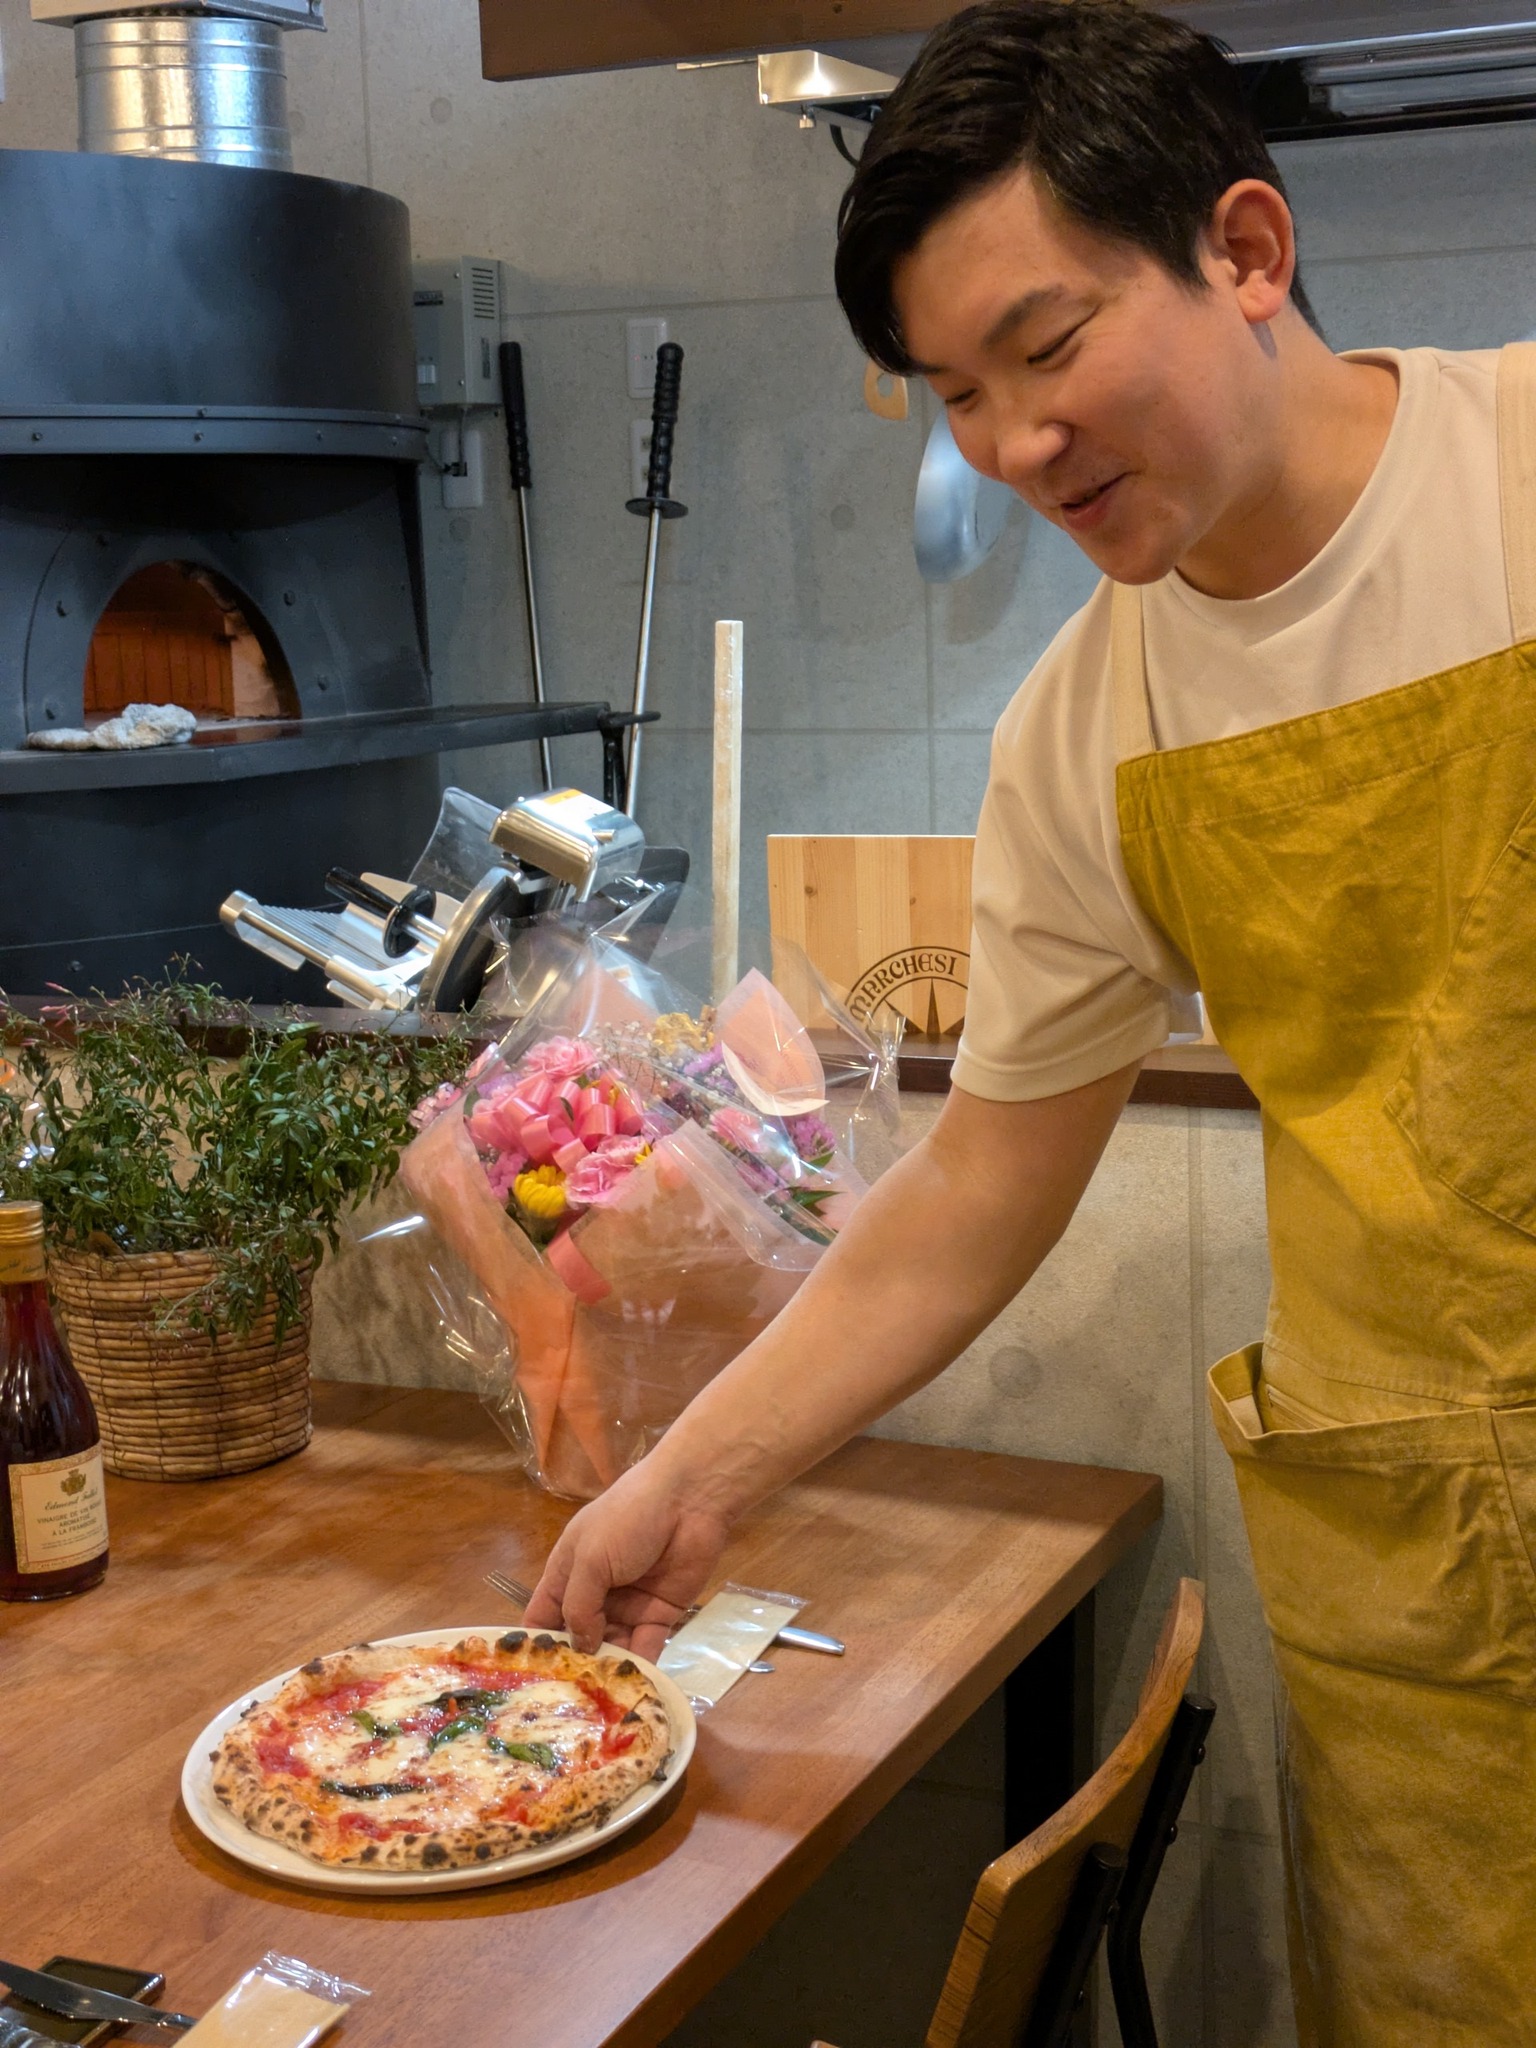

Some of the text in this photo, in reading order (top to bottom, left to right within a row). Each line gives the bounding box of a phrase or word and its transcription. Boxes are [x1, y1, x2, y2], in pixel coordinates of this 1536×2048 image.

[849, 953, 957, 1022] MARCHESI
[37, 1513, 67, 1523] VINAIGRE
[70, 1510, 77, 1518] DE
[59, 1528, 67, 1536] LA
